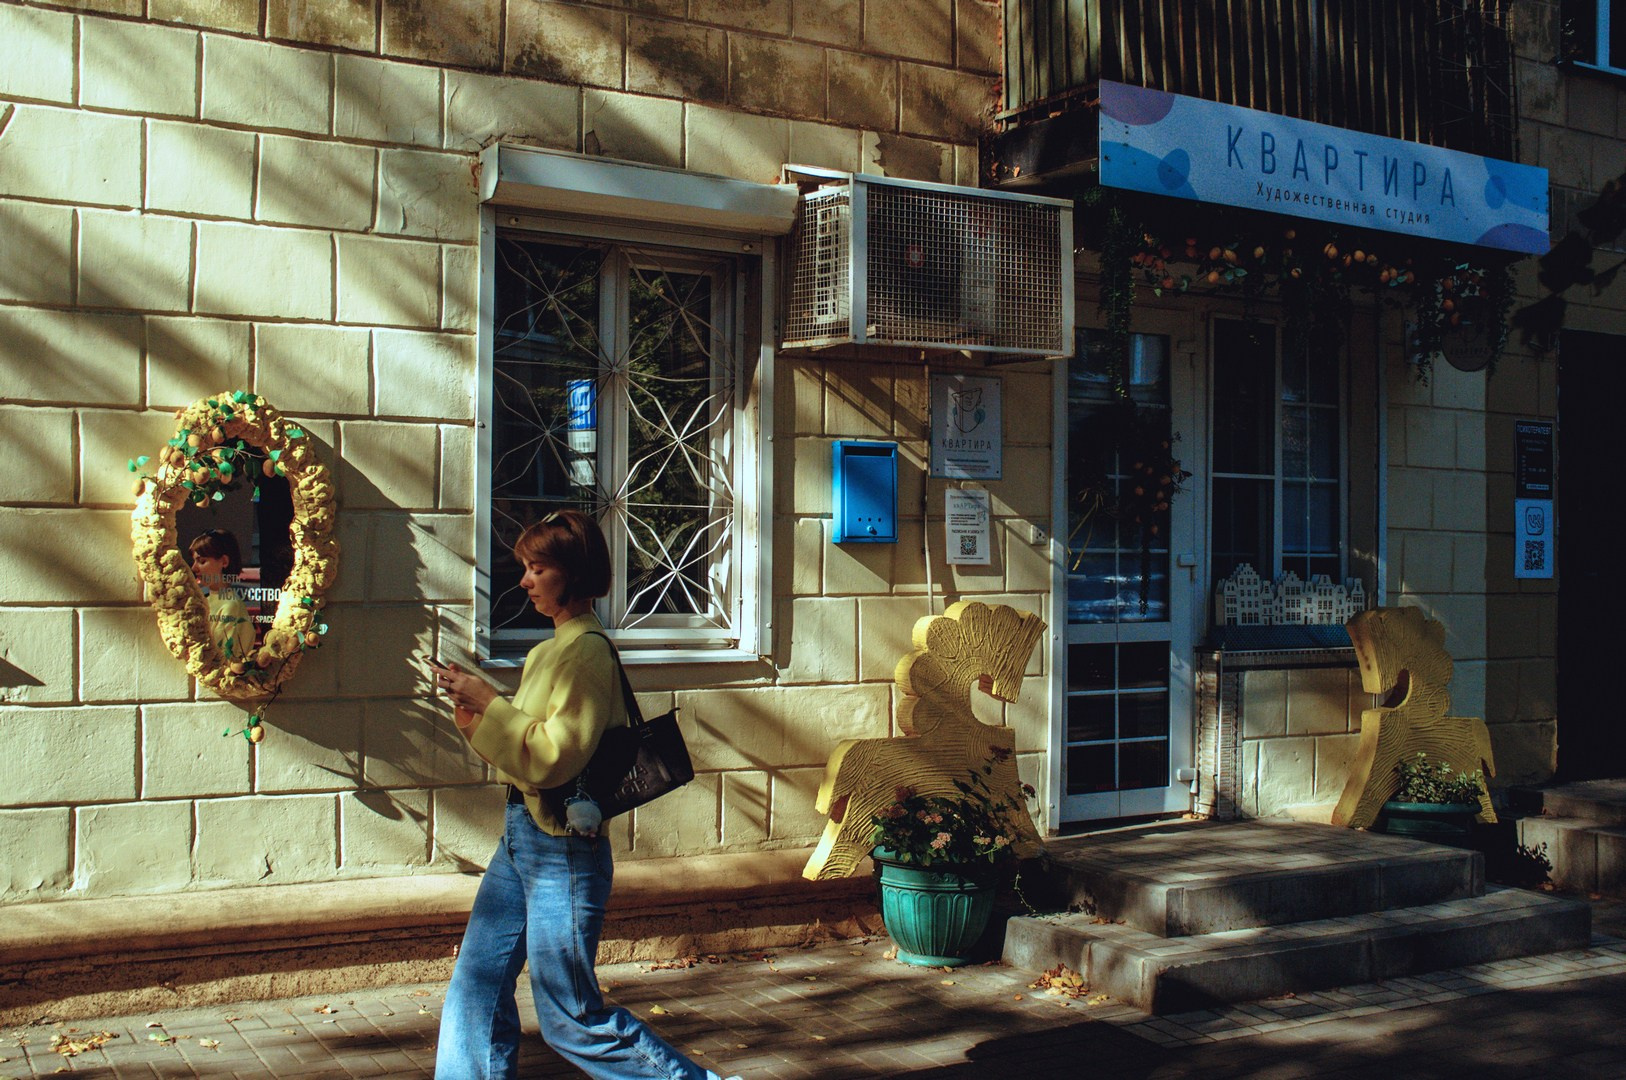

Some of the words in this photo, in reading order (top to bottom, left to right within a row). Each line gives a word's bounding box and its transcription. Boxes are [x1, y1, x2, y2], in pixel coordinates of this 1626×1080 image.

[1226, 124, 1457, 208] КВАРТИРА
[1255, 180, 1377, 217] Художественная
[1385, 206, 1431, 225] студия
[942, 438, 992, 450] КВАРТИРА
[218, 587, 281, 602] ИСКУССТВО
